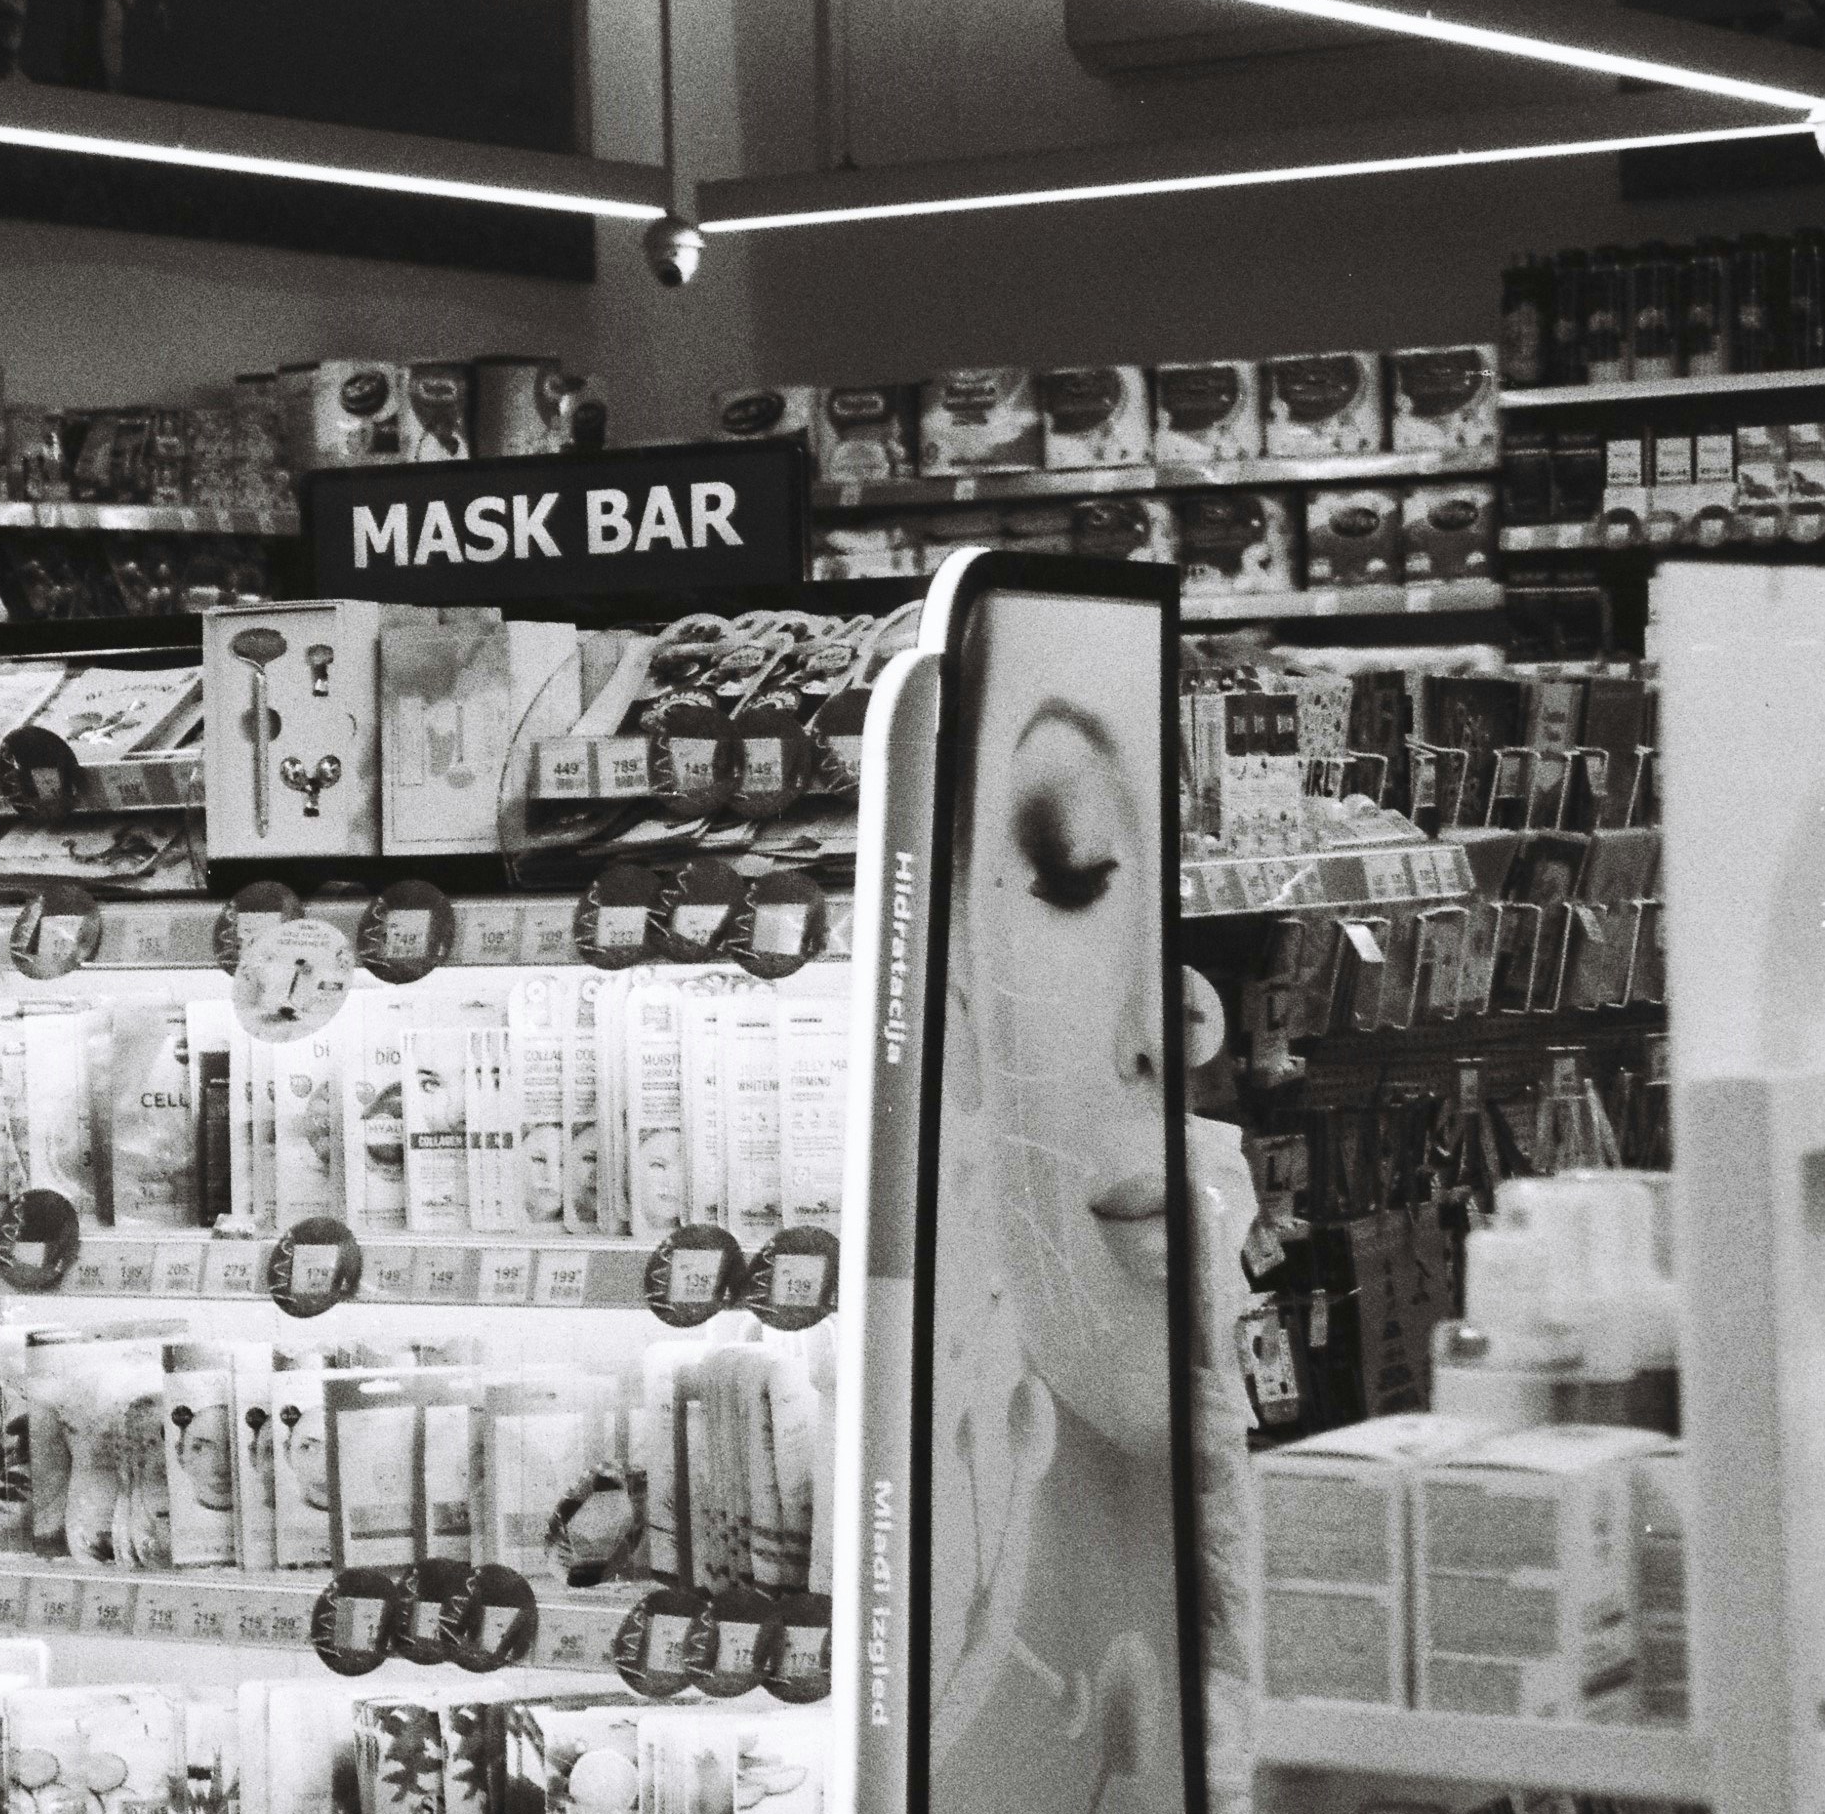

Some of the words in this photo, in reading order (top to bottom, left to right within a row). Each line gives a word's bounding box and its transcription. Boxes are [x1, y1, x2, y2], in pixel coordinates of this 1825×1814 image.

[353, 492, 562, 569] MASK
[586, 482, 744, 555] BAR
[884, 851, 915, 1064] Hidratacija
[868, 1606, 892, 1726] izgled
